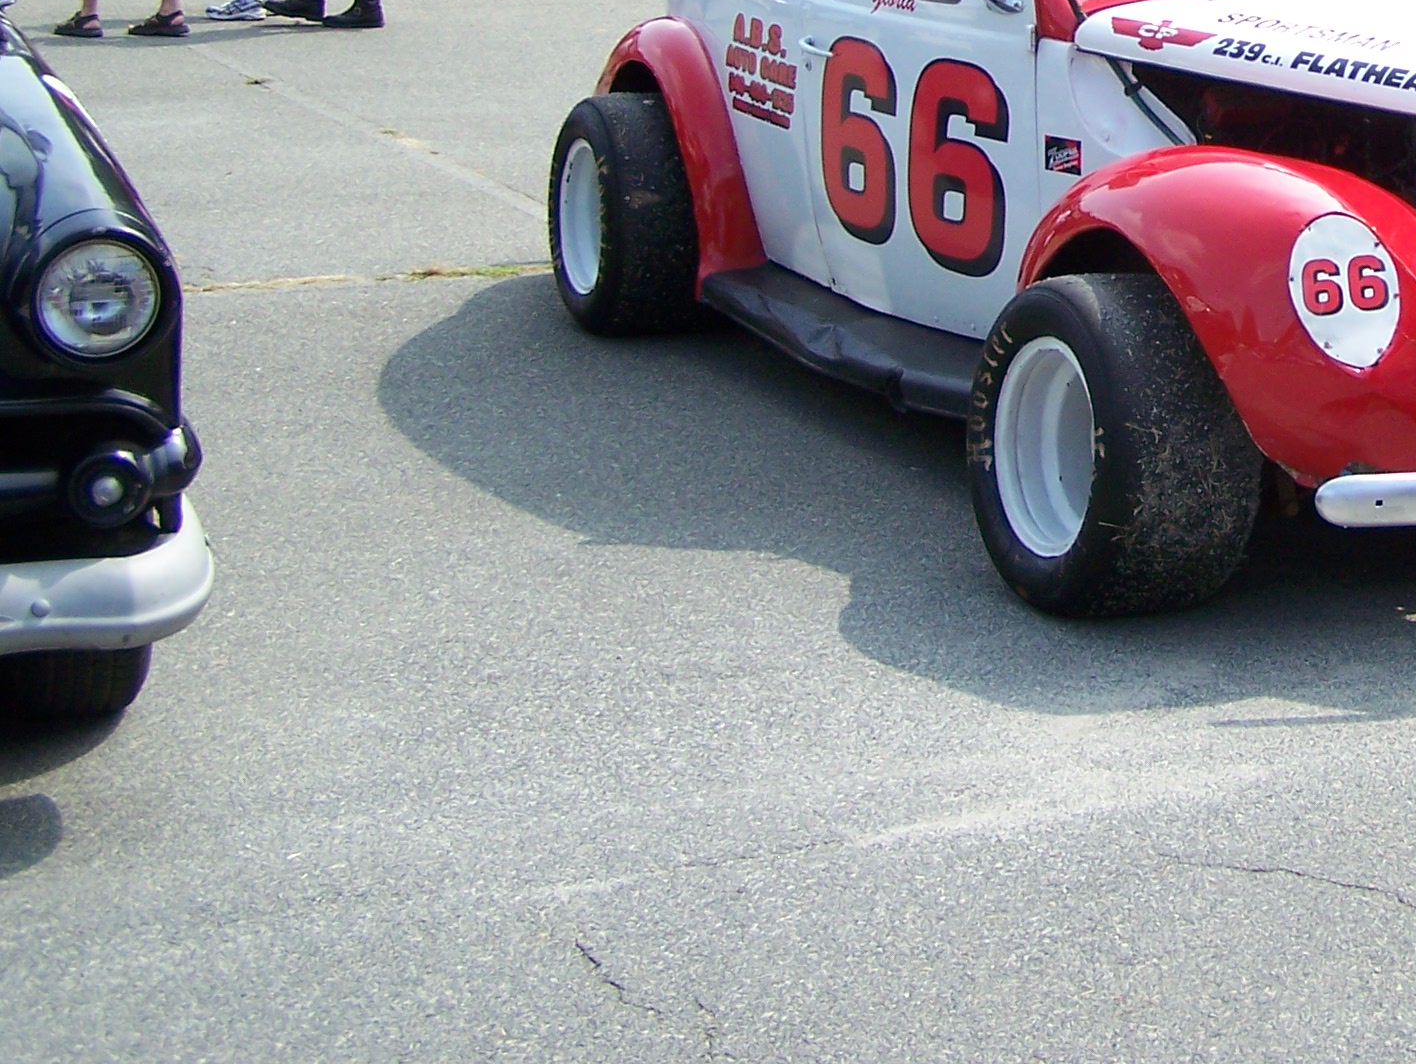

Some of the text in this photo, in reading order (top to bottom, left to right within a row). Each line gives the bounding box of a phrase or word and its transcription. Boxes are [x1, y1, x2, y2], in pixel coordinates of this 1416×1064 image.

[1217, 12, 1401, 52] SPORTSMAN
[820, 35, 1011, 278] 66
[1302, 255, 1389, 316] 66
